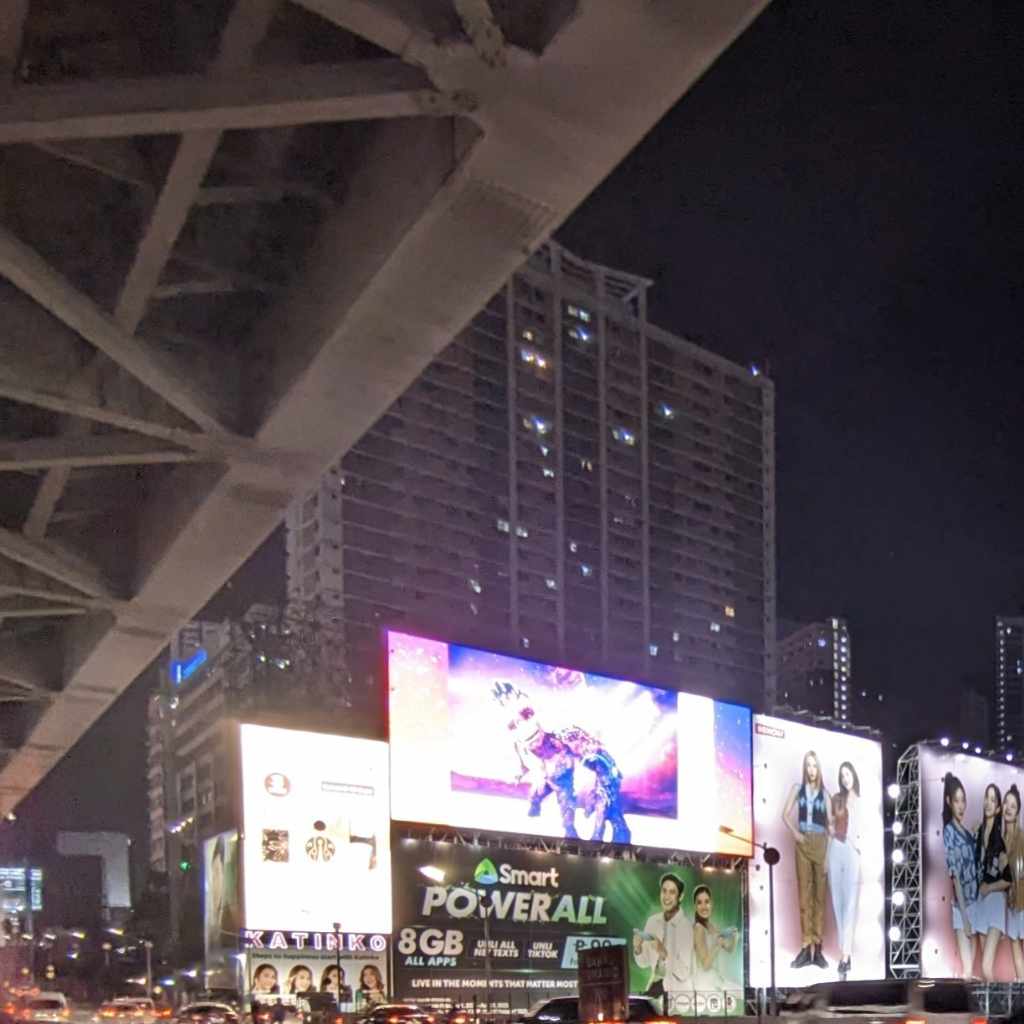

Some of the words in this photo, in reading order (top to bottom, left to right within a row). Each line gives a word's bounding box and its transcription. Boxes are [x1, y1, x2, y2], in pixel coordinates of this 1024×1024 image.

[500, 864, 559, 888] Smart
[244, 930, 386, 951] KATINKO
[405, 956, 425, 966] ALL
[427, 956, 457, 967] APPS
[412, 979, 430, 988] LIVE
[431, 979, 442, 988] IN
[443, 979, 460, 988] THE
[504, 979, 526, 988] THAT
